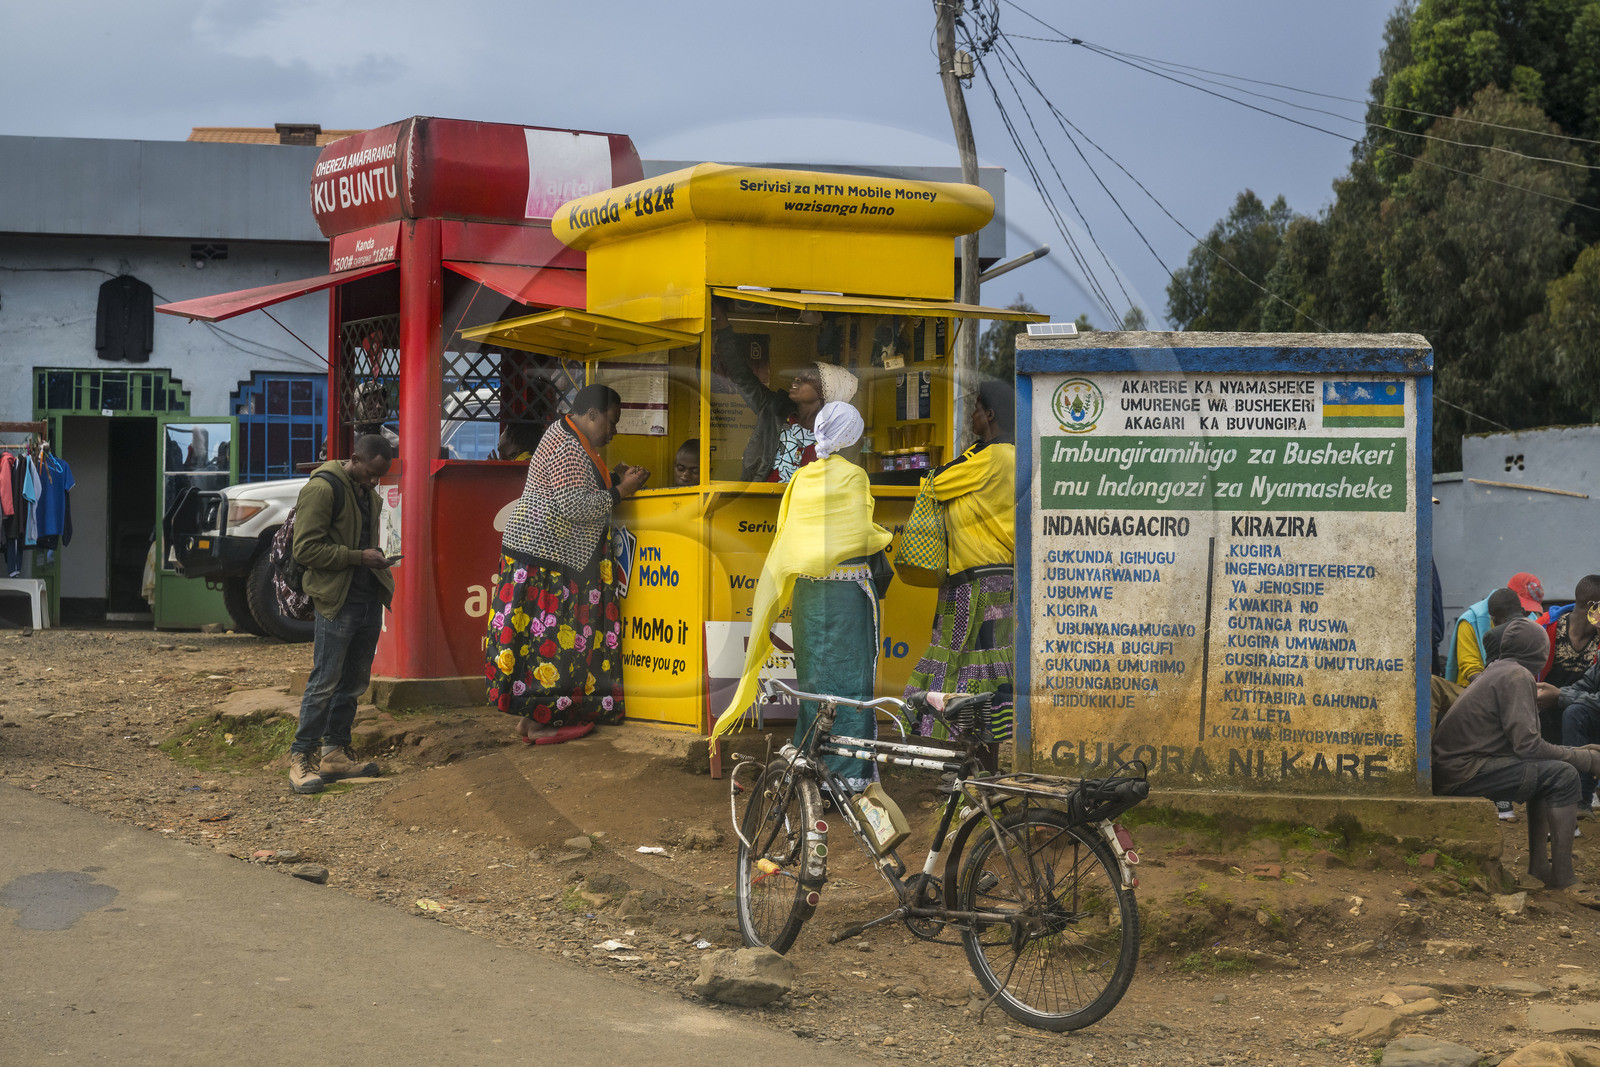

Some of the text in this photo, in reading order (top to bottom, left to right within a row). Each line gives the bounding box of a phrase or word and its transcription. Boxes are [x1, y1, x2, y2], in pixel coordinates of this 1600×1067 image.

[316, 142, 397, 177] OHEREZA AMAFARANGA
[314, 164, 397, 214] KU BUNTU
[547, 176, 594, 197] airtel
[740, 180, 937, 203] Serivisi za MTN Mobile Money
[569, 198, 621, 229] Kanda
[784, 200, 895, 216] wazisanga hano
[355, 237, 375, 252] Kanda
[1121, 380, 1315, 395] AKARERE KA NYAMASHEKE
[1120, 398, 1315, 412] UMURENGE WA BUSHEKERI
[1124, 416, 1307, 431] AKAGARI KA BUVUNGIRA
[1051, 440, 1394, 471] Imbungiramihigo za Bushekeri
[1052, 474, 1393, 505] mu Indongozi za Nyamasheke
[1043, 516, 1190, 537] INDANGAGACIRO
[1231, 516, 1317, 537] KIRAZIRA
[640, 547, 661, 561] MTN
[1120, 551, 1175, 565] IGIHUGU
[639, 565, 679, 587] MoMo
[1225, 562, 1375, 579] INGENGABITEKEREZO
[1232, 580, 1325, 596] YA JENOSIDE
[1300, 600, 1319, 614] NO
[632, 616, 673, 644] MoMo
[678, 619, 688, 645] it
[1056, 622, 1196, 638] UBUNYANGAMUGAYO
[1228, 616, 1349, 633] GUTANGA RUSWA
[1121, 641, 1173, 655] BUGUFI
[1285, 636, 1357, 652] UMWANDA
[652, 656, 670, 673] you
[672, 659, 686, 675] go
[1118, 659, 1185, 674] UMURIMO
[1314, 656, 1404, 672] UMUTURAGE
[1053, 694, 1135, 709] IBIDUKIKIJE
[1312, 694, 1378, 710] GAHUNDA
[1231, 707, 1292, 723] ZA LETA
[1278, 729, 1404, 748] IBIYOBYABWENGE
[1051, 740, 1389, 783] GUKORA NI KARE
